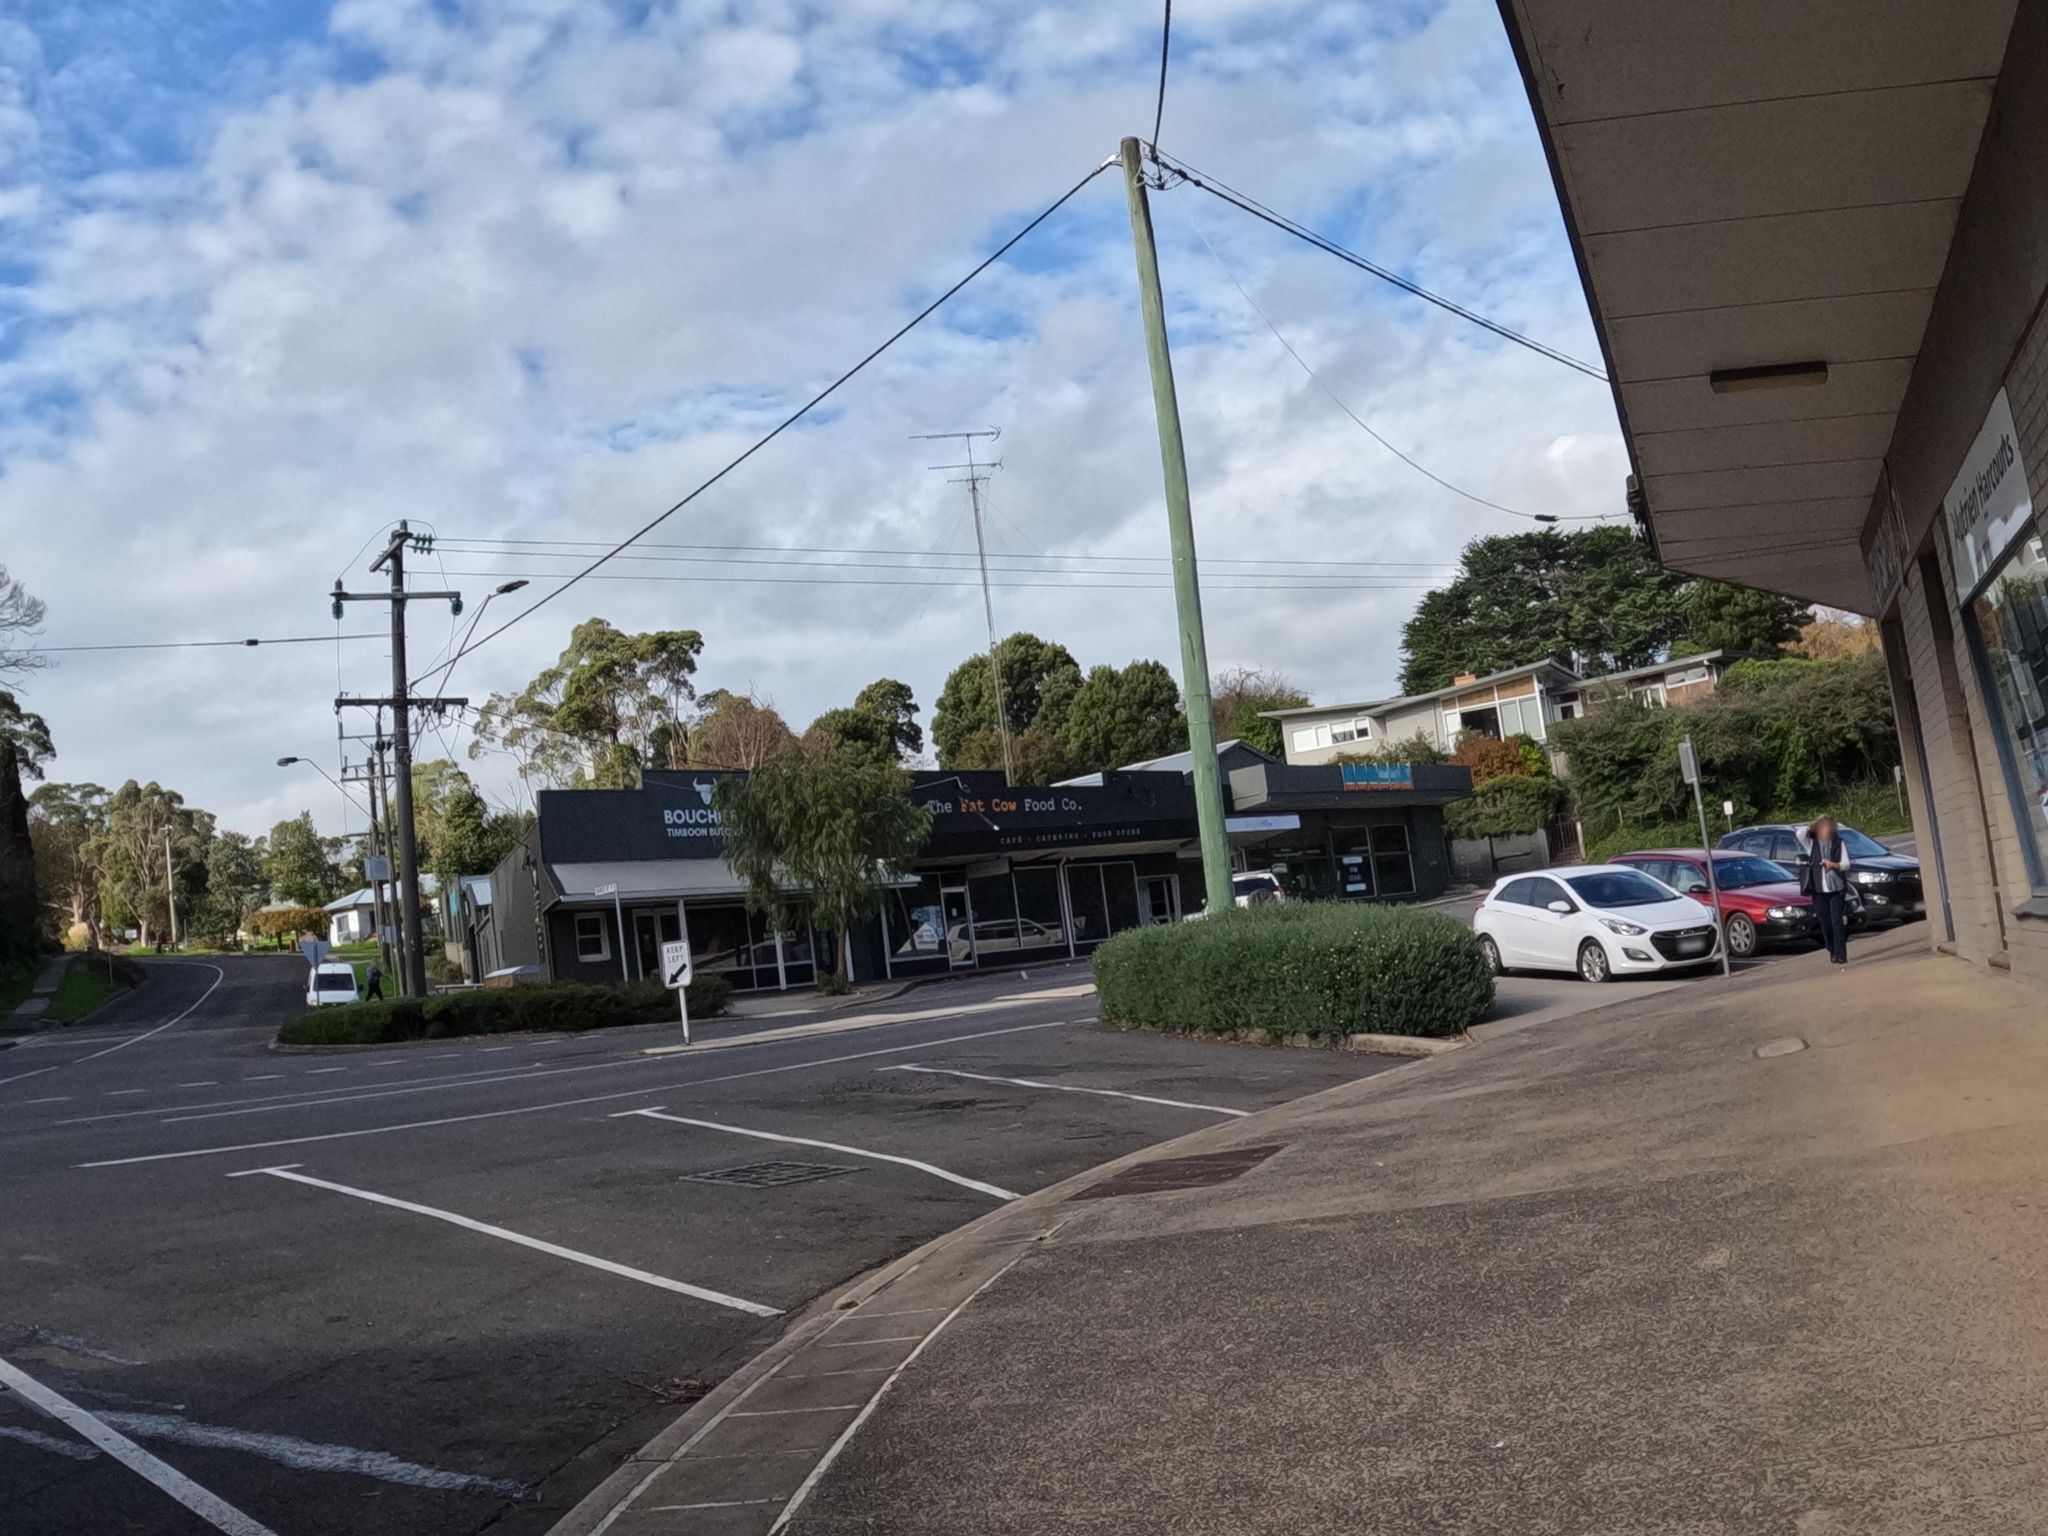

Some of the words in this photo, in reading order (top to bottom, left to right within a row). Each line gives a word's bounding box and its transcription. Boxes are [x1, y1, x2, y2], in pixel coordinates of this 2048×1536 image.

[1975, 433, 2015, 508] Harcourts
[928, 800, 953, 814] The
[959, 798, 985, 813] Fat
[991, 798, 1017, 812] Cow
[1024, 797, 1056, 812] Food
[1061, 797, 1083, 811] Co.
[666, 827, 708, 838] TIMBOON
[666, 945, 684, 954] KEEP
[667, 954, 685, 964] LEFT
